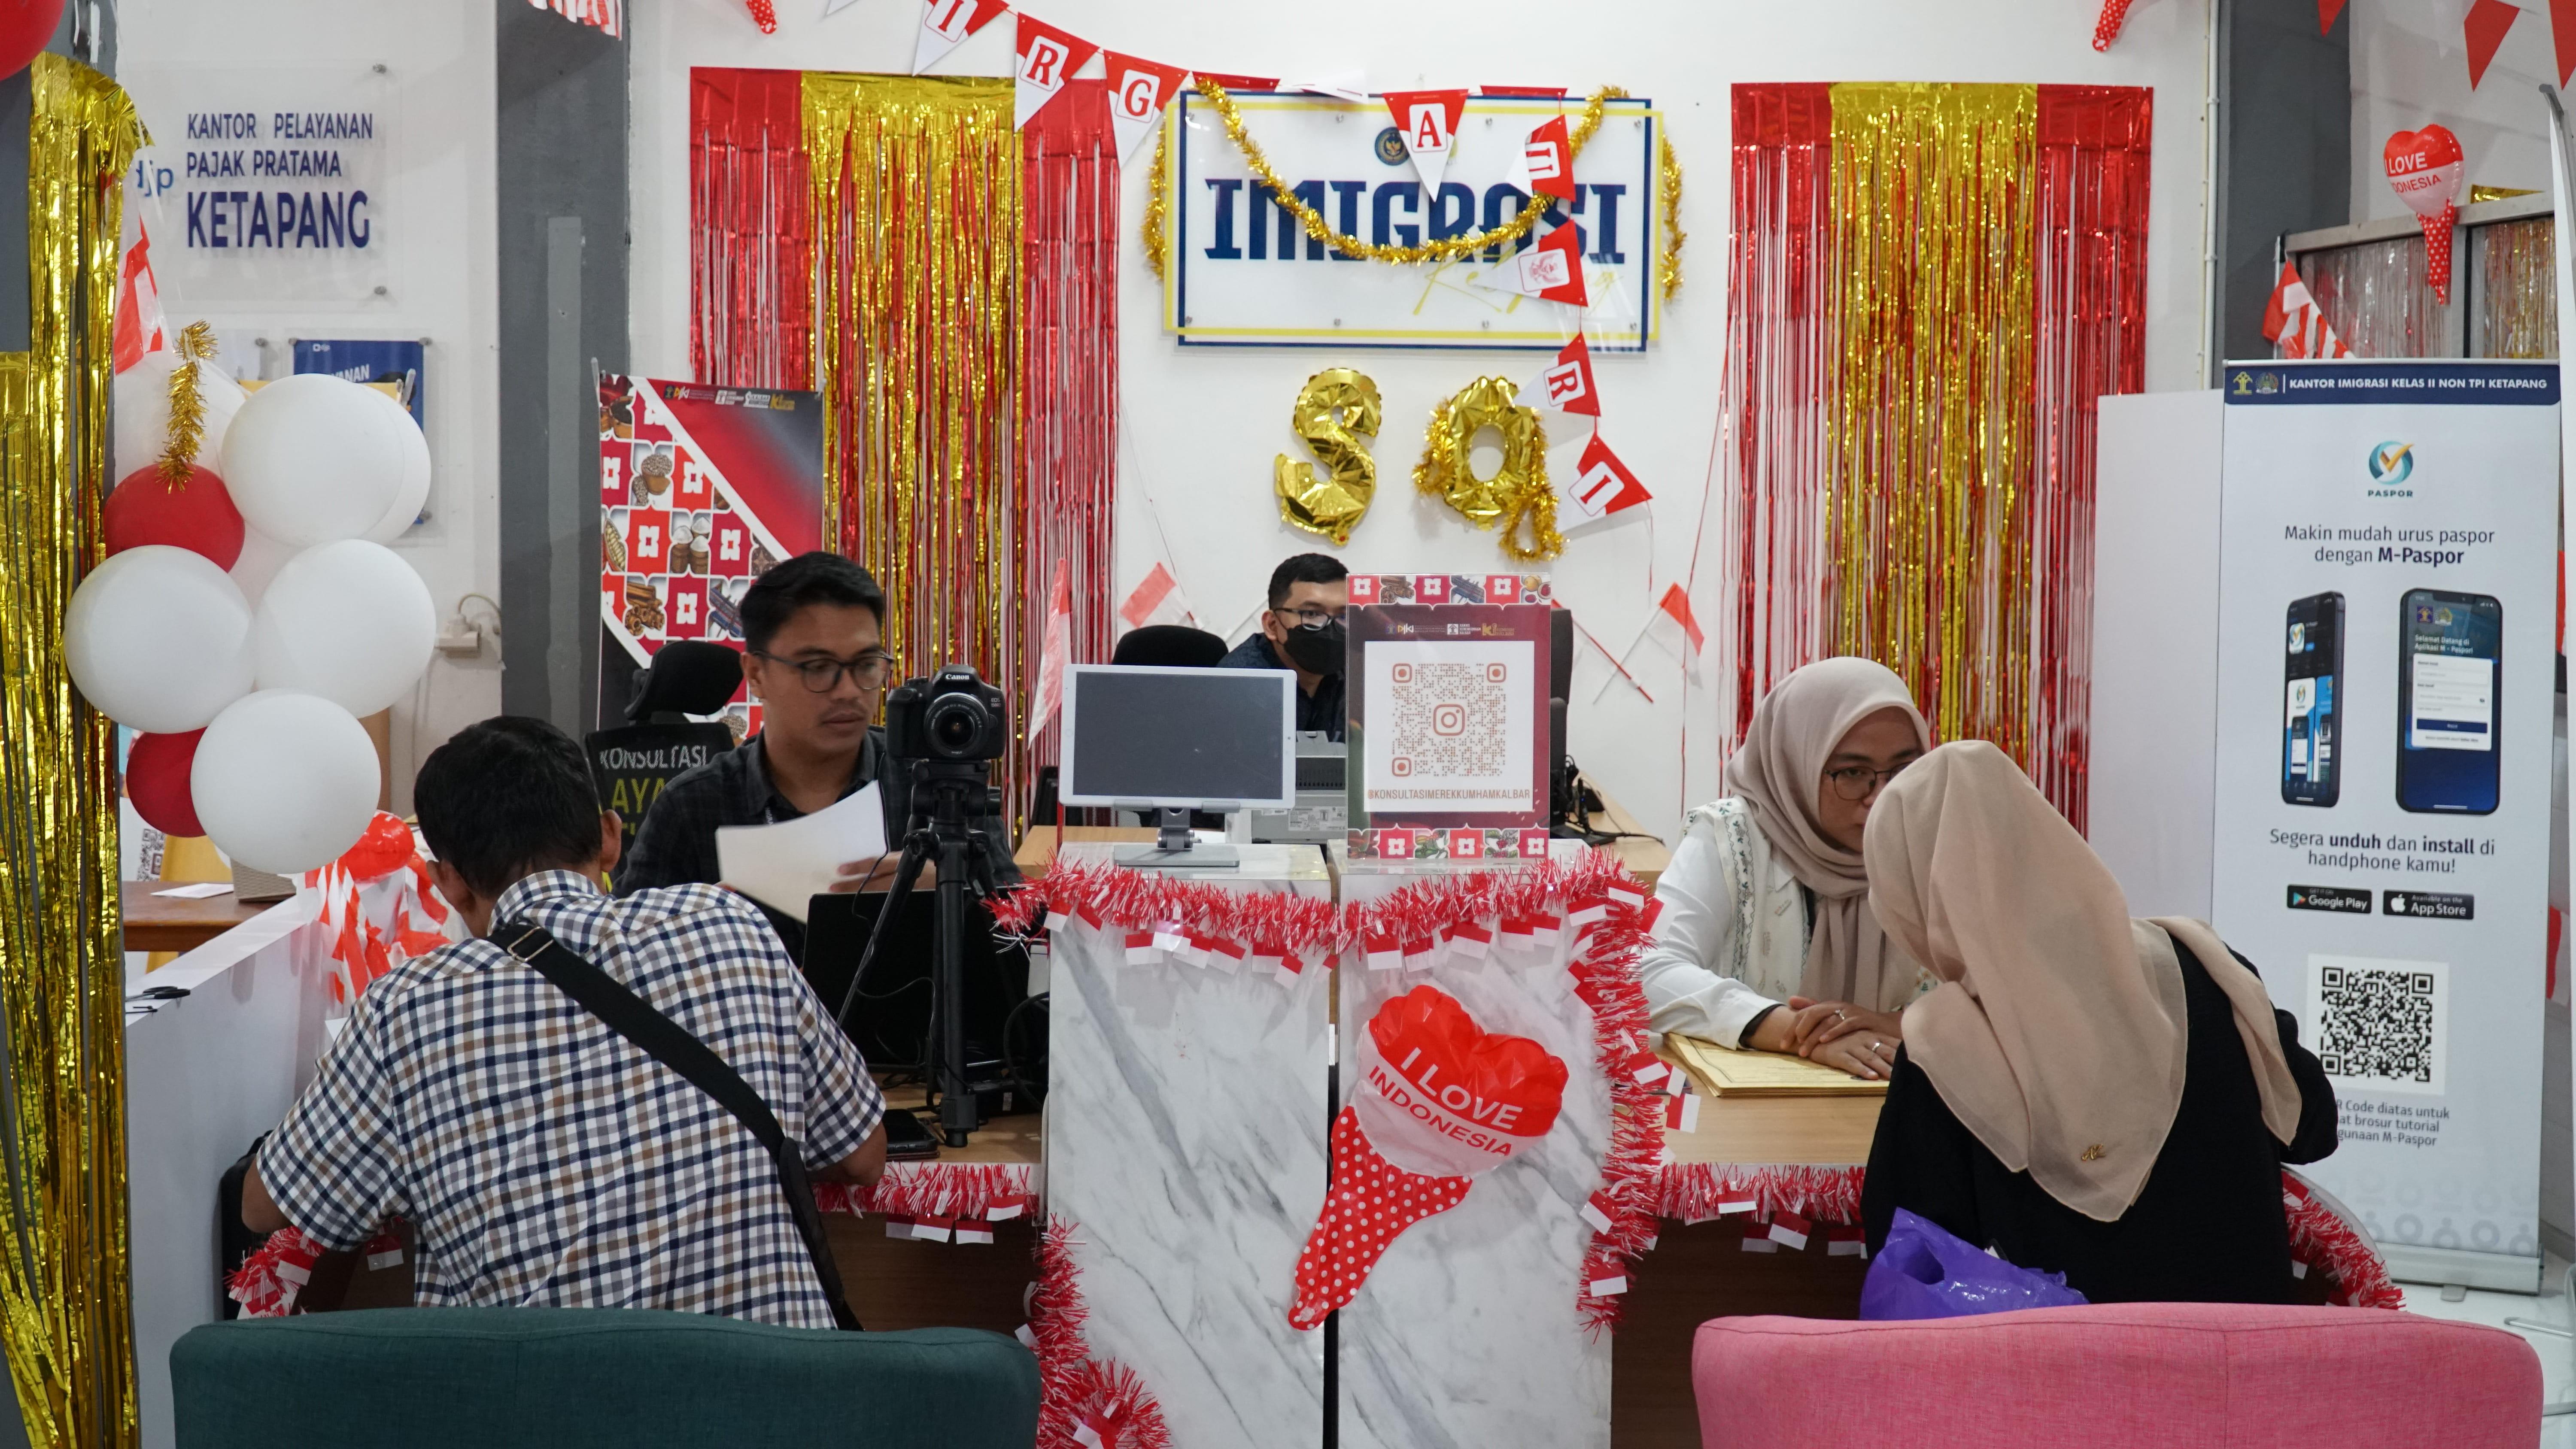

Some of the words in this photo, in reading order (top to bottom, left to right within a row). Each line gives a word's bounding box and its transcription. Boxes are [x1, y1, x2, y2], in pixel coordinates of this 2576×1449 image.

[188, 113, 256, 139] KANTOR
[274, 113, 373, 139] PELAYANAN
[187, 150, 245, 177] PAJAK
[254, 150, 342, 177] PRATAMA
[2389, 152, 2428, 174] LOVE
[187, 190, 370, 249] KETAPANG
[2289, 379, 2335, 388] KANTOR
[2338, 378, 2388, 388] IMIGRASI
[2392, 378, 2424, 388] KELAS
[2428, 379, 2435, 388] II
[2439, 379, 2465, 388] NON
[2469, 379, 2485, 388] TPI
[2489, 379, 2547, 388] KETAPANG
[2285, 524, 2332, 540] Makin
[2338, 525, 2392, 542] mudah
[2399, 528, 2433, 542] urus
[2439, 529, 2494, 546] paspor
[2315, 546, 2372, 566] dengan
[2378, 547, 2464, 567] M-Paspor
[2415, 634, 2440, 643] Selamat
[1367, 789, 1530, 799] @KONSULTASIMEREKKUMHAMKALBAR
[2270, 828, 2324, 849] Segera
[2330, 833, 2381, 849] unduh
[2387, 835, 2417, 851] dan
[2423, 836, 2475, 854] install
[2480, 839, 2495, 855] di
[2309, 850, 2401, 871] handphone
[2406, 855, 2455, 873] kamu!
[2309, 894, 2344, 909] Google
[2345, 897, 2367, 911] Play
[2411, 902, 2434, 916] App
[2436, 903, 2467, 916] Store
[1400, 1047, 1422, 1071] I
[1418, 1063, 1523, 1130] LOVE
[1368, 1065, 1513, 1157] INDONESIA
[2346, 1100, 2374, 1113] Code
[2377, 1102, 2413, 1116] diatas
[2416, 1106, 2450, 1119] untuk
[2355, 1114, 2393, 1128] brosur
[2396, 1119, 2439, 1132] tutorial
[2382, 1131, 2437, 1149] M-Paspor
